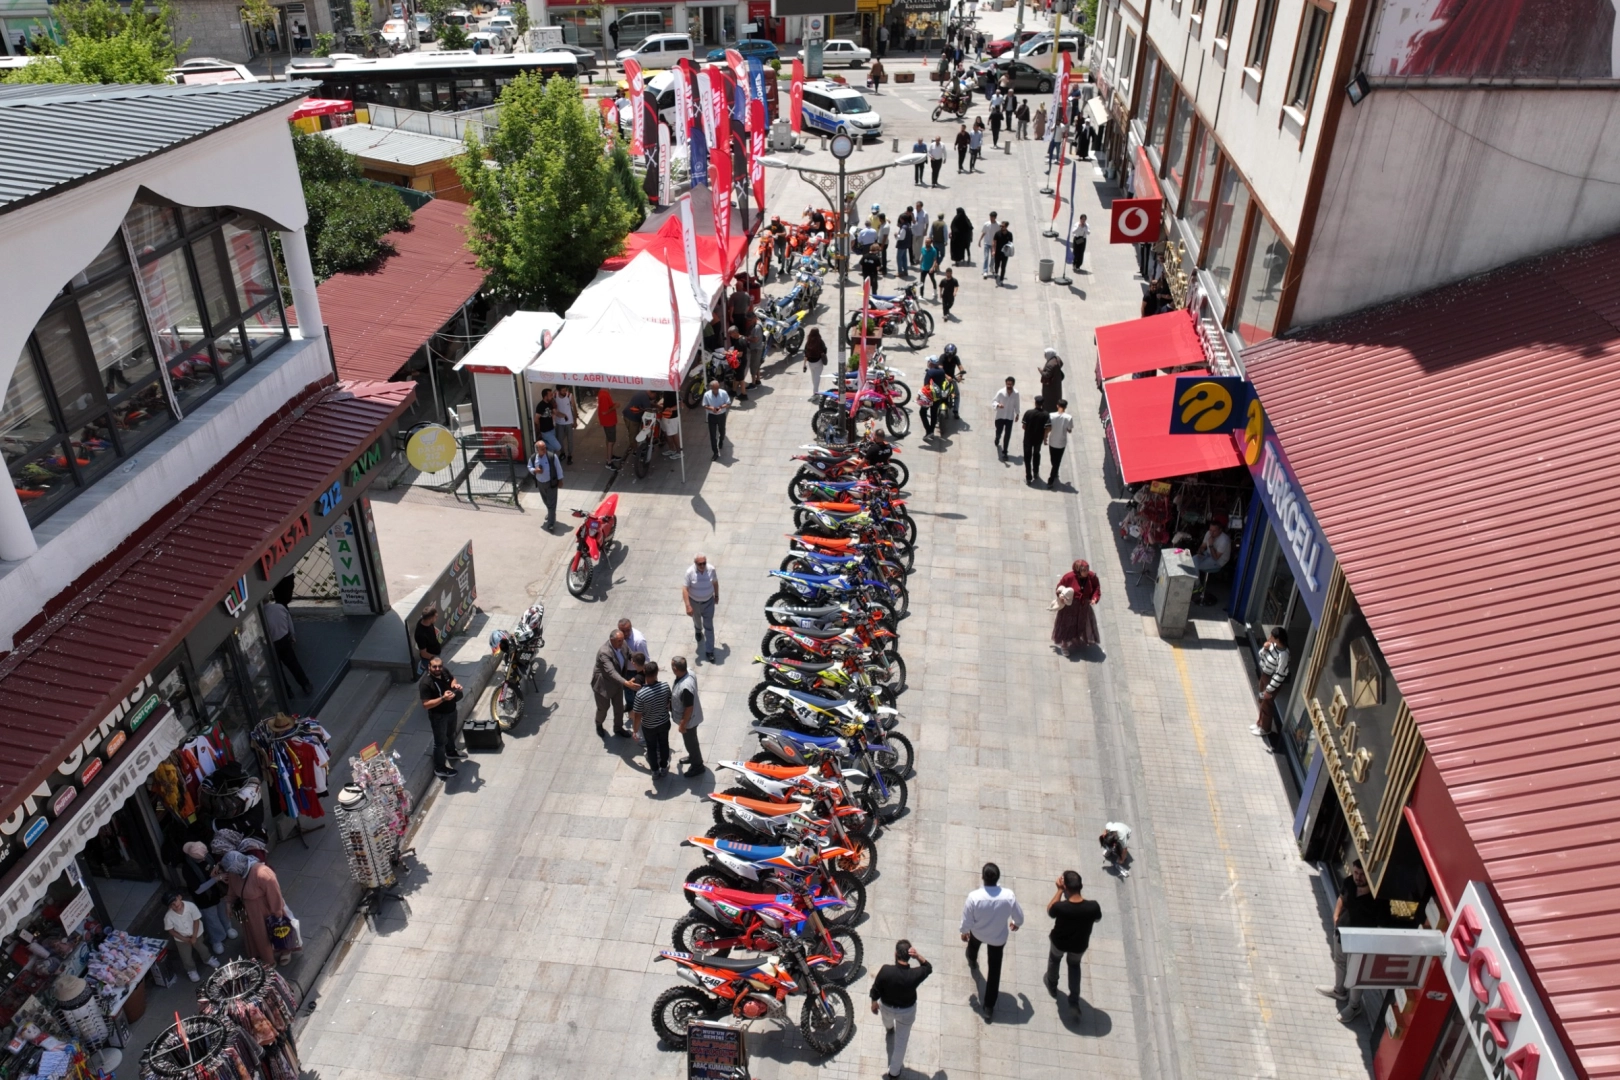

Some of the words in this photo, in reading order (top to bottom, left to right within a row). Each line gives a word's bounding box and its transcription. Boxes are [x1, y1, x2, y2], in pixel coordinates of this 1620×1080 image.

[583, 373, 605, 382] AĞRI
[606, 375, 644, 385] VALİLİĞİ
[319, 480, 343, 517] 212
[351, 443, 382, 487] AVM
[1262, 441, 1321, 593] TURKCELL
